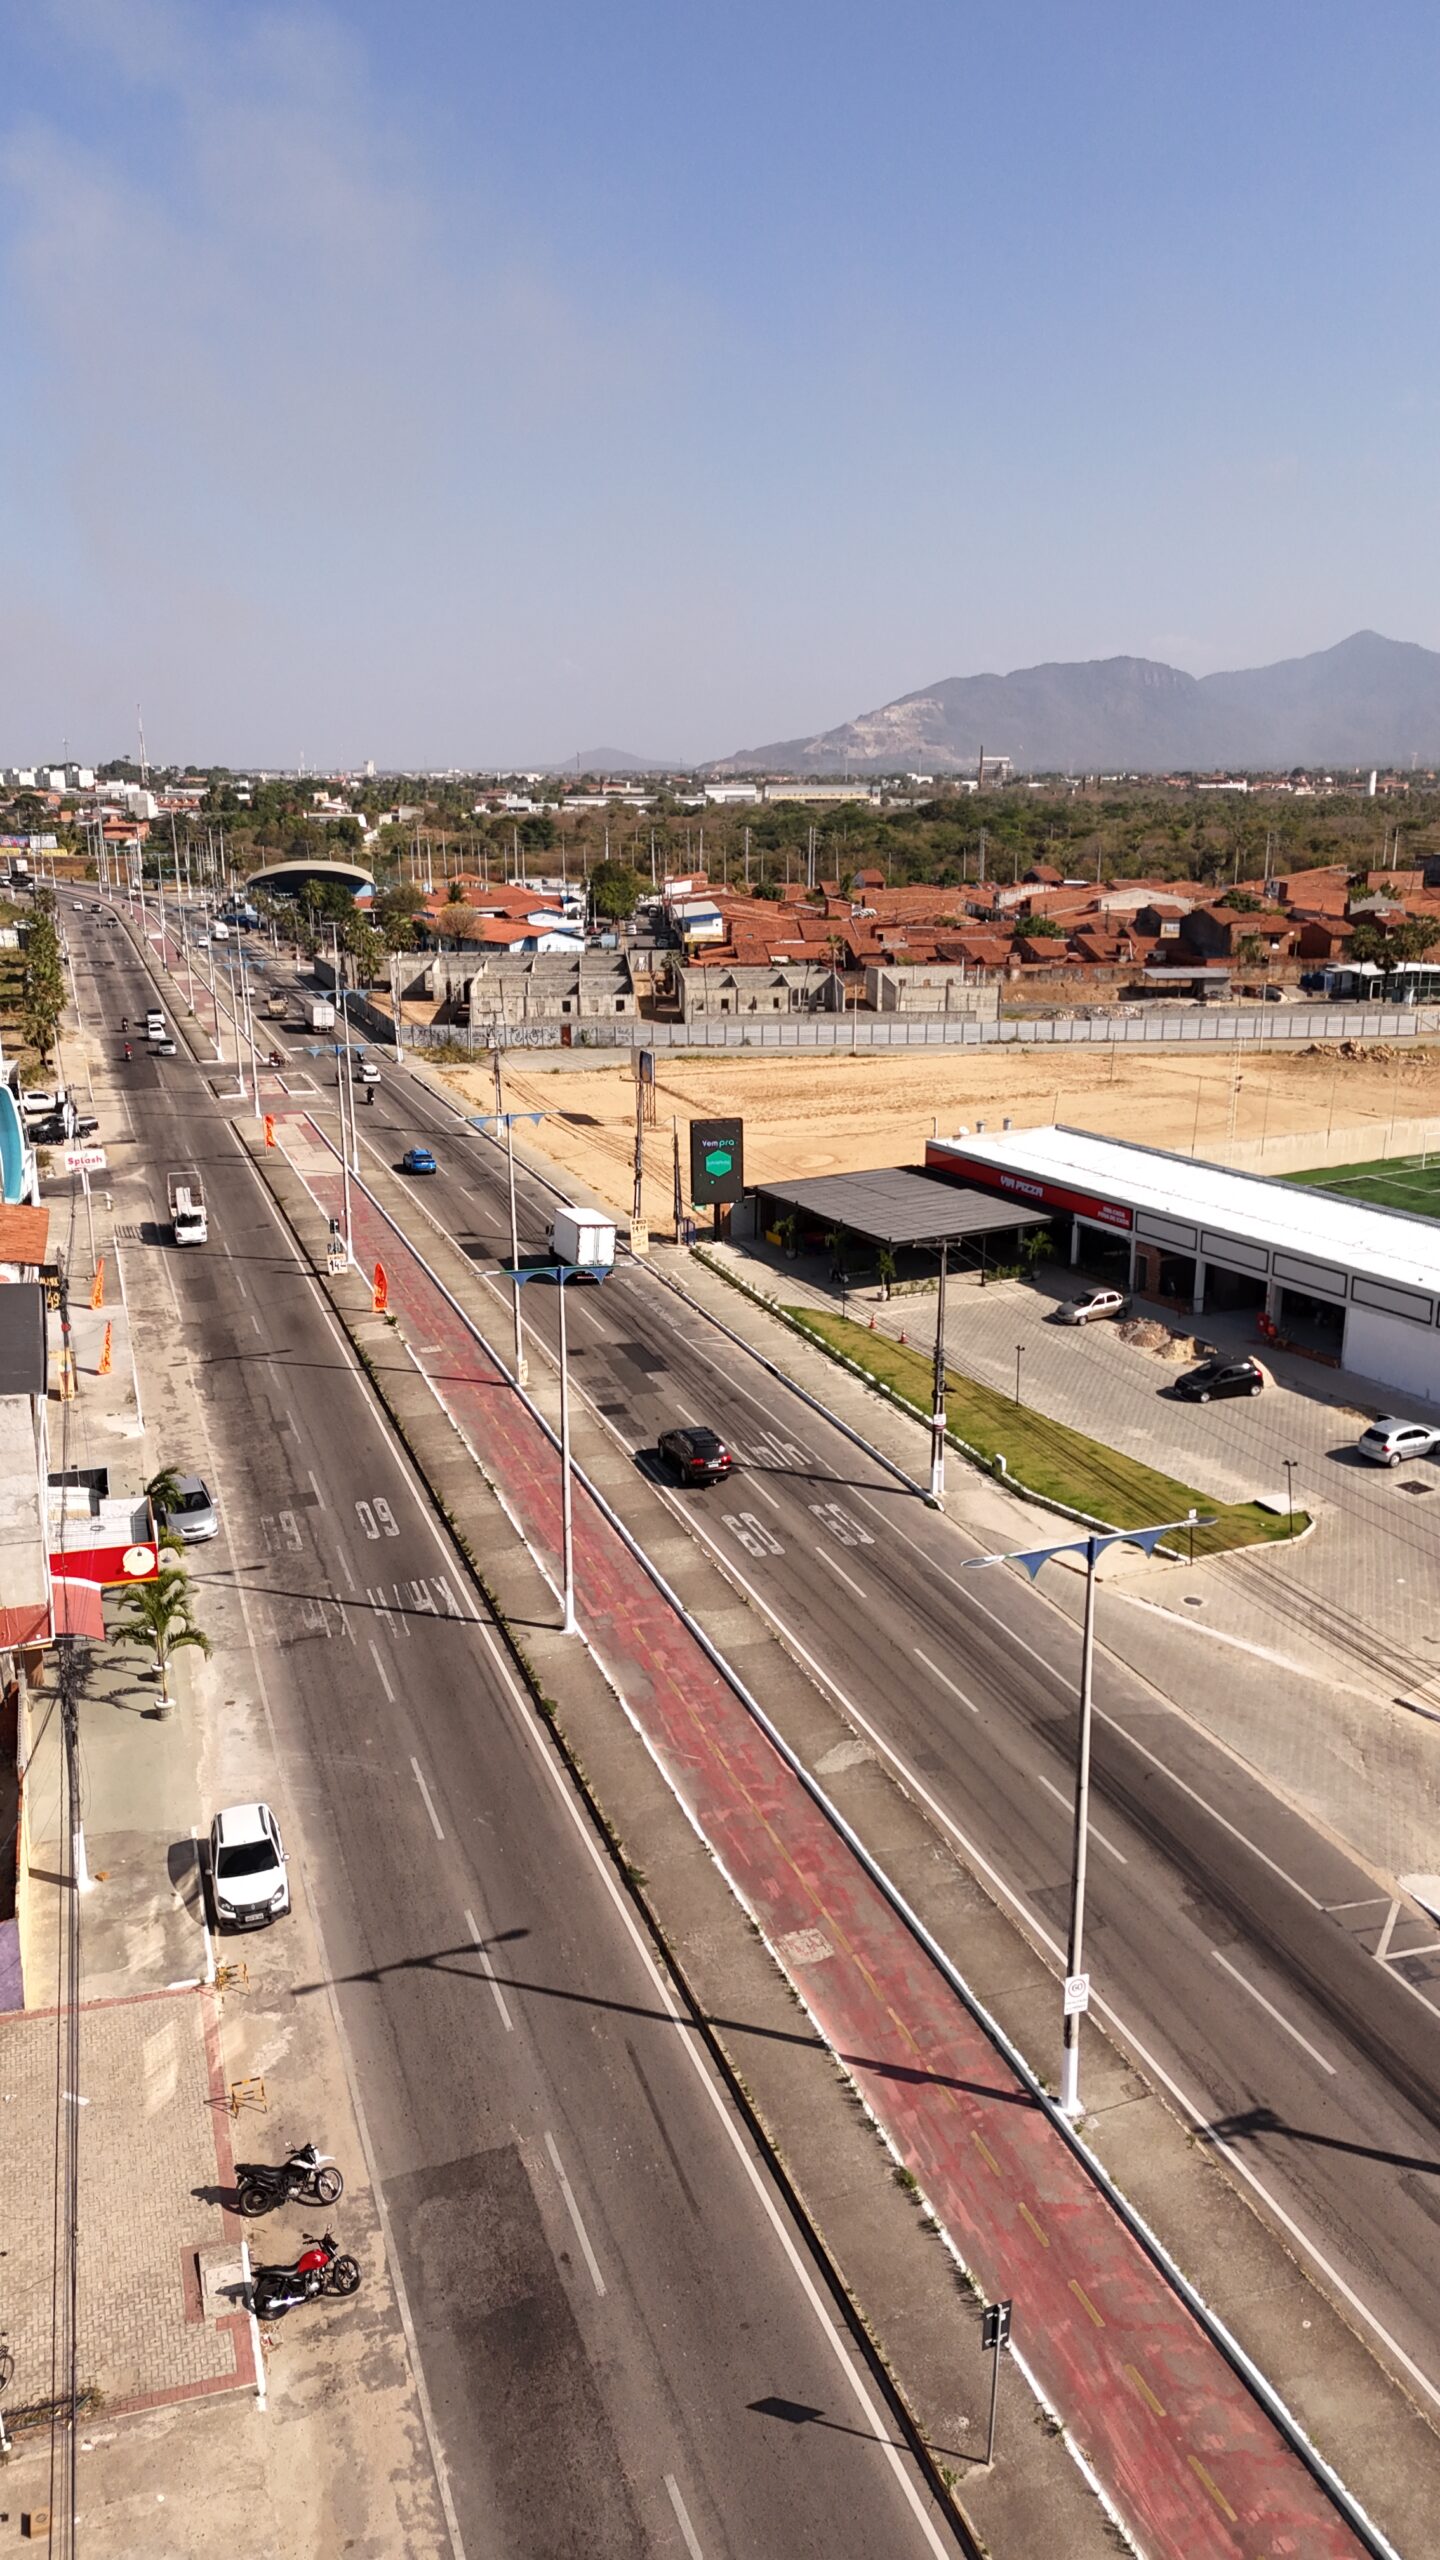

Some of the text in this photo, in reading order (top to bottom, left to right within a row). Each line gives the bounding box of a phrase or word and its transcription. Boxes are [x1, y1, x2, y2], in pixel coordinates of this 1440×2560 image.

[719, 1139, 735, 1148] pra
[67, 1155, 103, 1166] Splash
[1015, 1180, 1043, 1198] PIZZA
[355, 1497, 400, 1540] 60
[808, 1503, 875, 1546] 60
[720, 1512, 786, 1558] 60
[1071, 1982, 1083, 1992] 60
